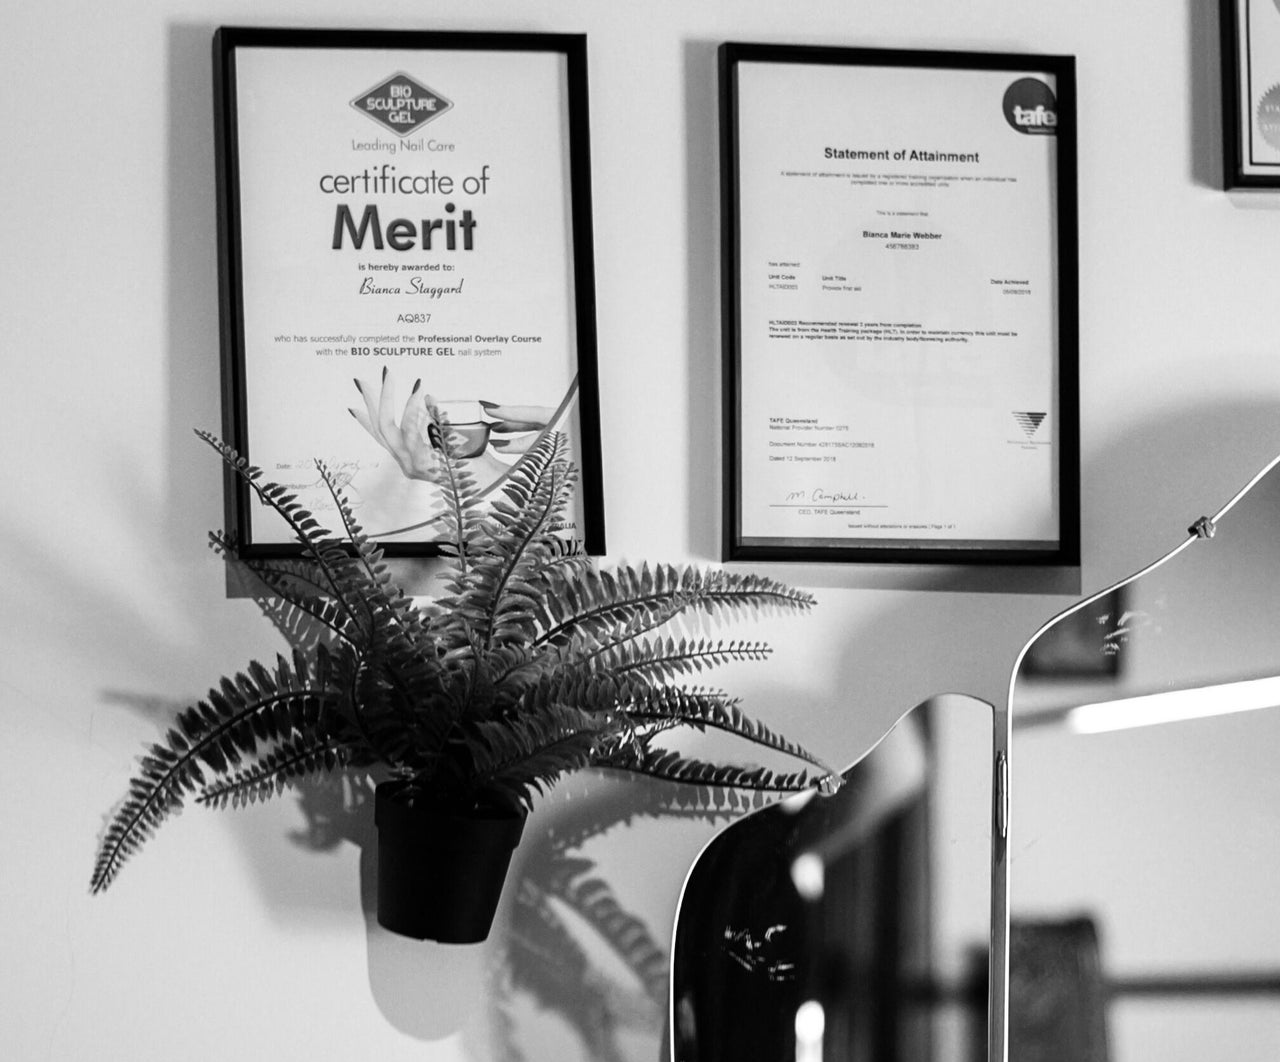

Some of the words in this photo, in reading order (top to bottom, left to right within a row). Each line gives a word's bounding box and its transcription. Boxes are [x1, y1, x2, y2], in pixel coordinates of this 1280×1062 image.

[390, 85, 412, 98] BIO
[366, 97, 437, 112] SCULPTURE
[388, 111, 416, 124] GEL
[1012, 104, 1058, 126] tafe
[351, 138, 397, 154] Leading
[400, 139, 424, 152] Nail
[427, 140, 456, 153] Care
[824, 147, 890, 162] Statement
[893, 149, 907, 161] of
[909, 149, 980, 164] Attainment
[319, 164, 454, 195] certificate
[462, 165, 491, 195] of
[331, 202, 478, 251] Merit
[862, 230, 889, 239] Bianca
[891, 231, 912, 239] Marie
[913, 232, 942, 240] Webber
[358, 263, 366, 272] is
[368, 262, 399, 273] hereby
[401, 263, 441, 272] awarded
[442, 263, 456, 272] to:
[358, 276, 401, 295] Bianca
[405, 276, 465, 299] Staggard
[396, 313, 432, 324] AQ837
[274, 335, 291, 344] who
[293, 335, 308, 344] has
[310, 335, 357, 344] successfully
[359, 335, 400, 344] completed
[402, 335, 416, 344] the
[417, 335, 473, 344] Professional
[475, 335, 509, 344] Overlay
[511, 335, 542, 344] Course
[315, 348, 333, 357] with
[334, 348, 348, 357] the
[350, 348, 371, 357] BIO
[373, 348, 433, 357] SCULPTURE
[435, 348, 455, 357] GEL
[457, 348, 472, 357] nail
[473, 348, 502, 357] system
